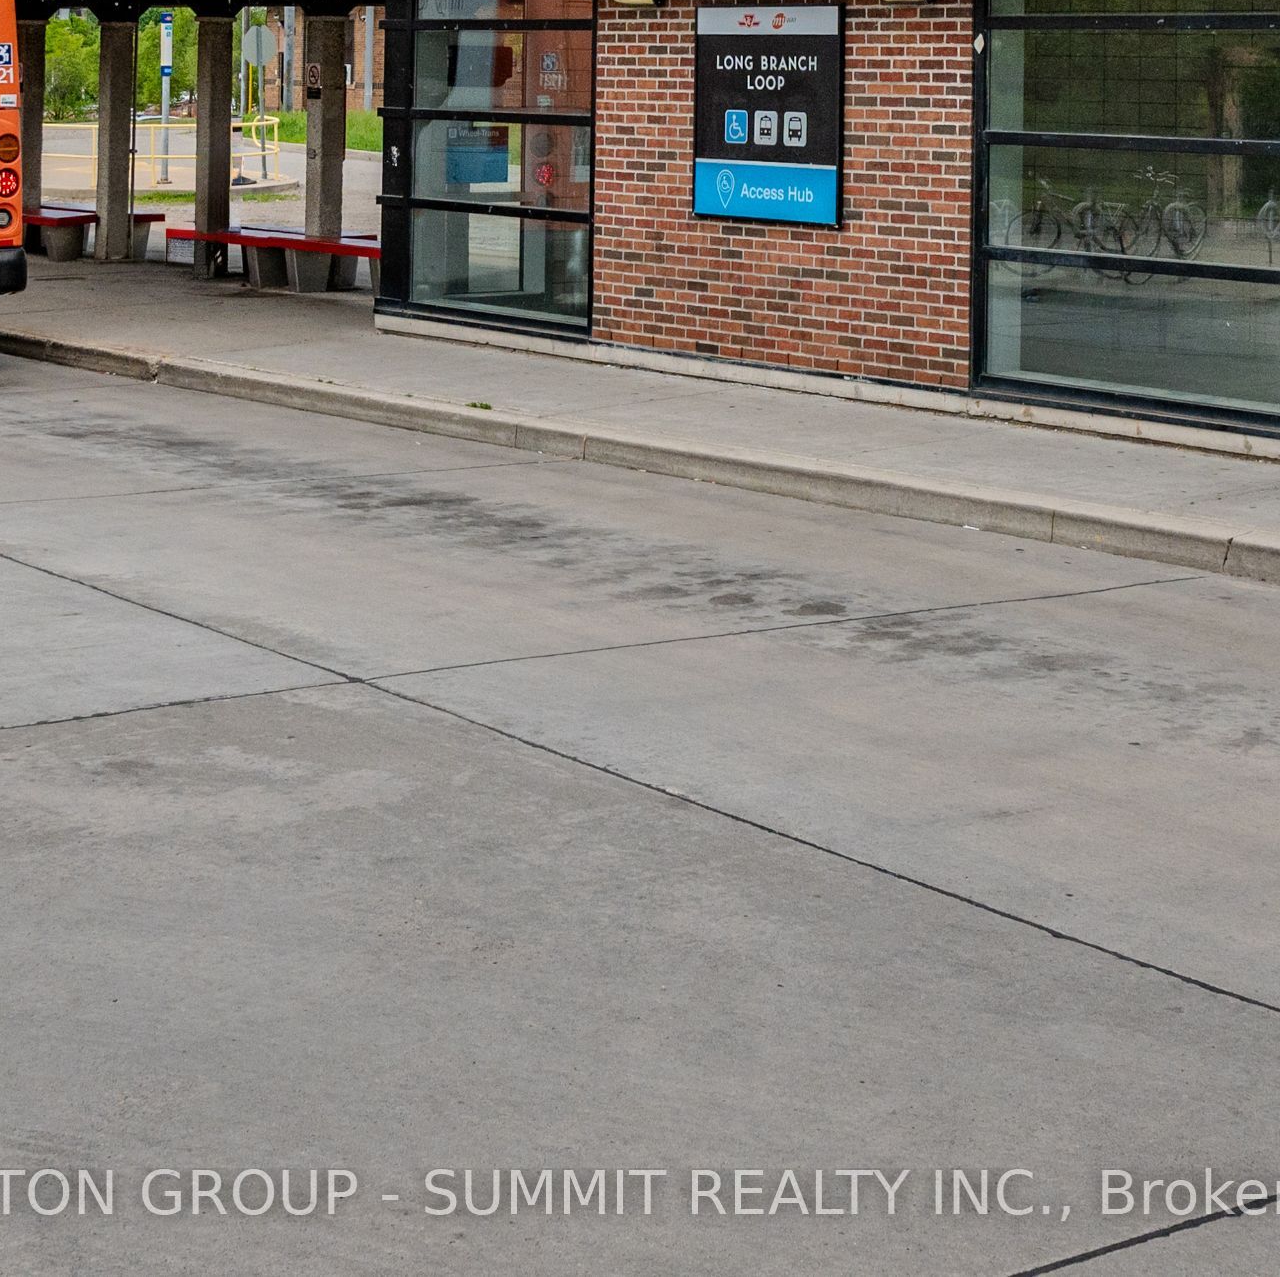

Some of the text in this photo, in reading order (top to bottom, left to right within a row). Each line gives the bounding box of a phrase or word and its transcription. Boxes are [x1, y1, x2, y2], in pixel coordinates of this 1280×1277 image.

[716, 55, 817, 71] LONG BRANCH
[747, 75, 785, 90] LOOP
[740, 183, 813, 203] Access Hub
